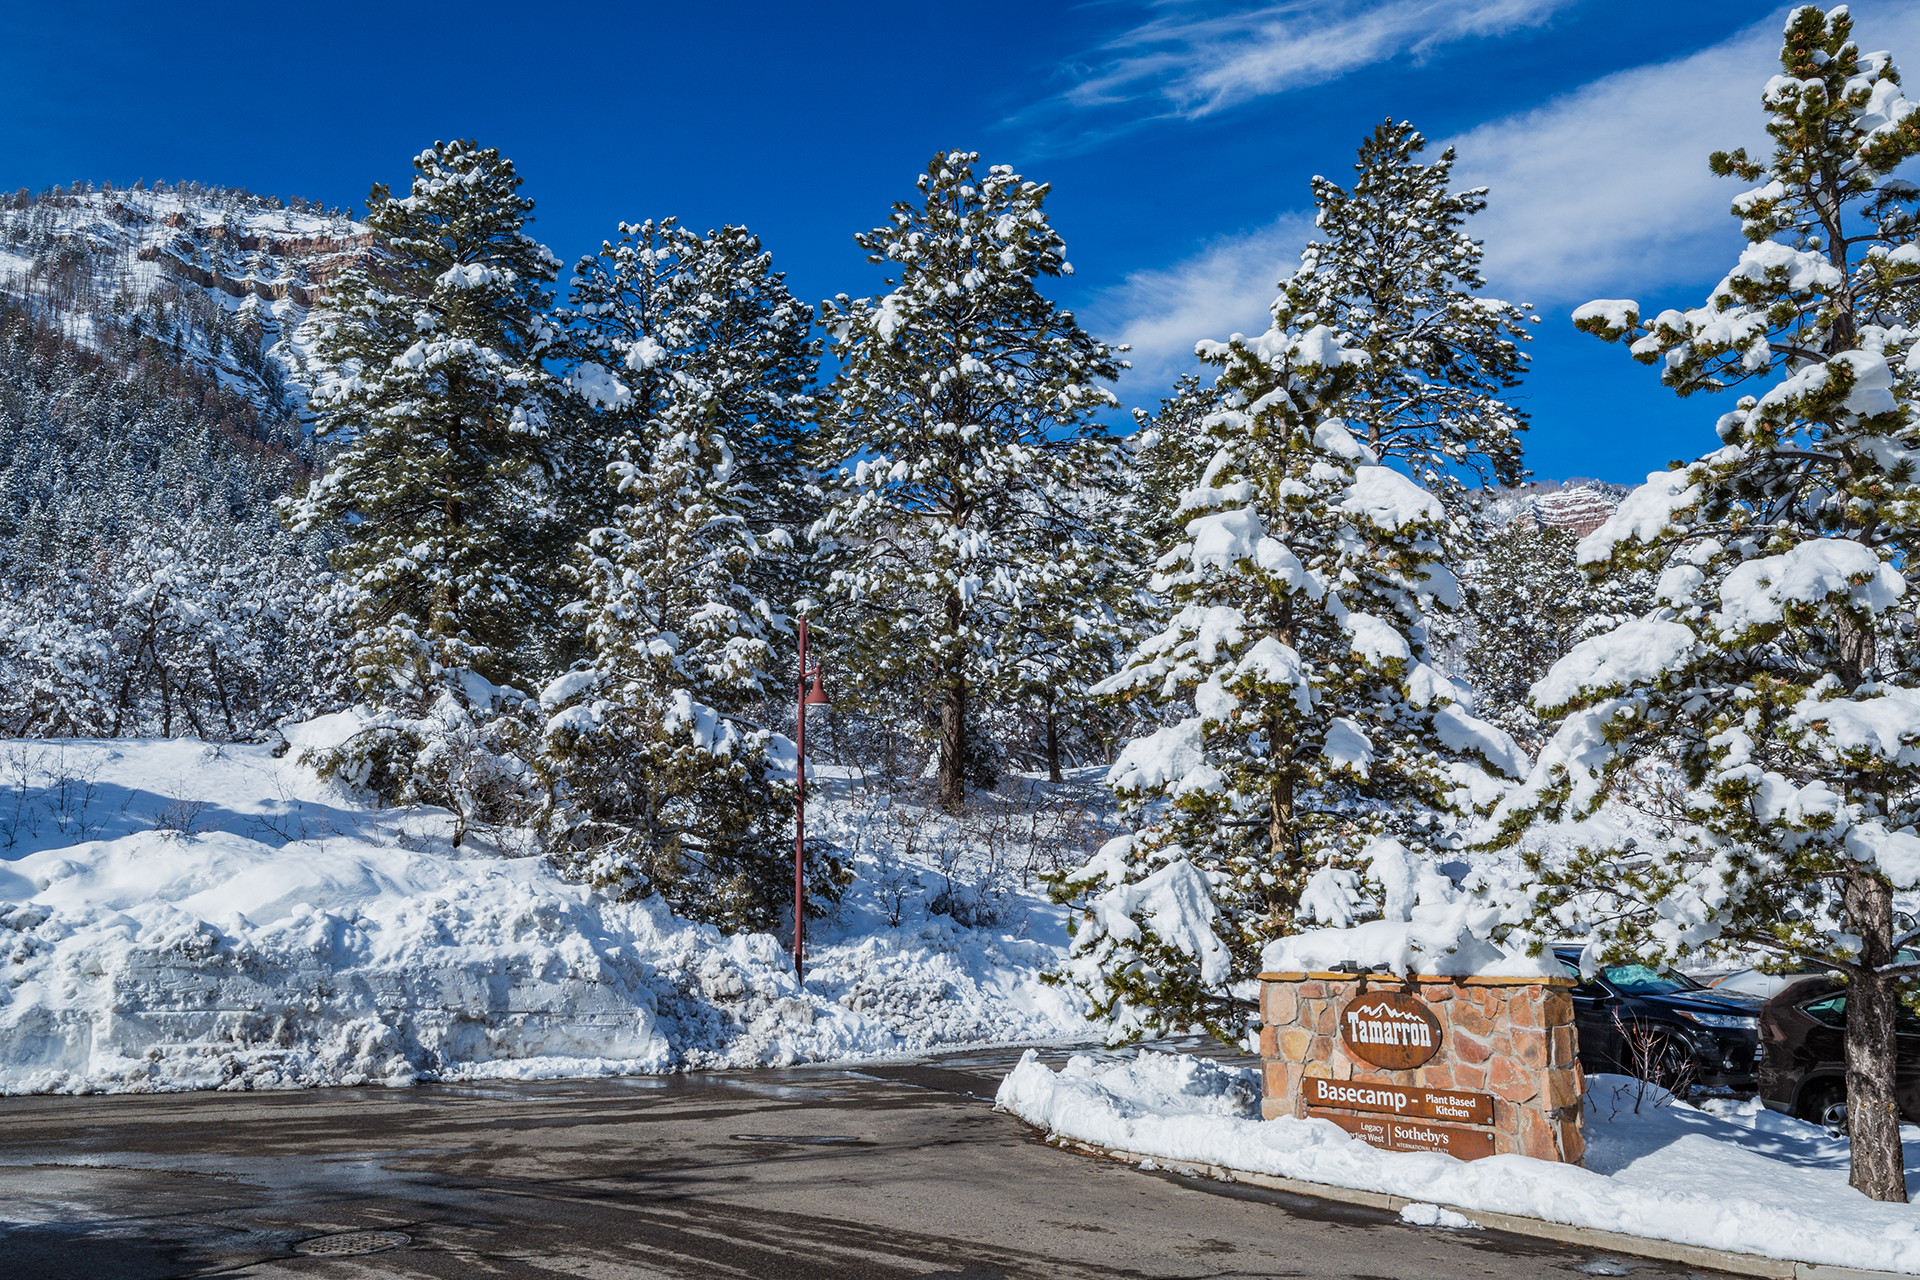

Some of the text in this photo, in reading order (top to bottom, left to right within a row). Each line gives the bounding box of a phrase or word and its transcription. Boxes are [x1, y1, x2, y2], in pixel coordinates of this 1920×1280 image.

[1347, 1012, 1431, 1047] Tamarron
[1317, 1080, 1407, 1112] Basecamp
[1425, 1093, 1476, 1108] Plant Based
[1435, 1106, 1469, 1118] Kitchen
[1360, 1122, 1384, 1134] Legacy
[1367, 1133, 1384, 1143] West
[1394, 1126, 1449, 1146] Sotheby's
